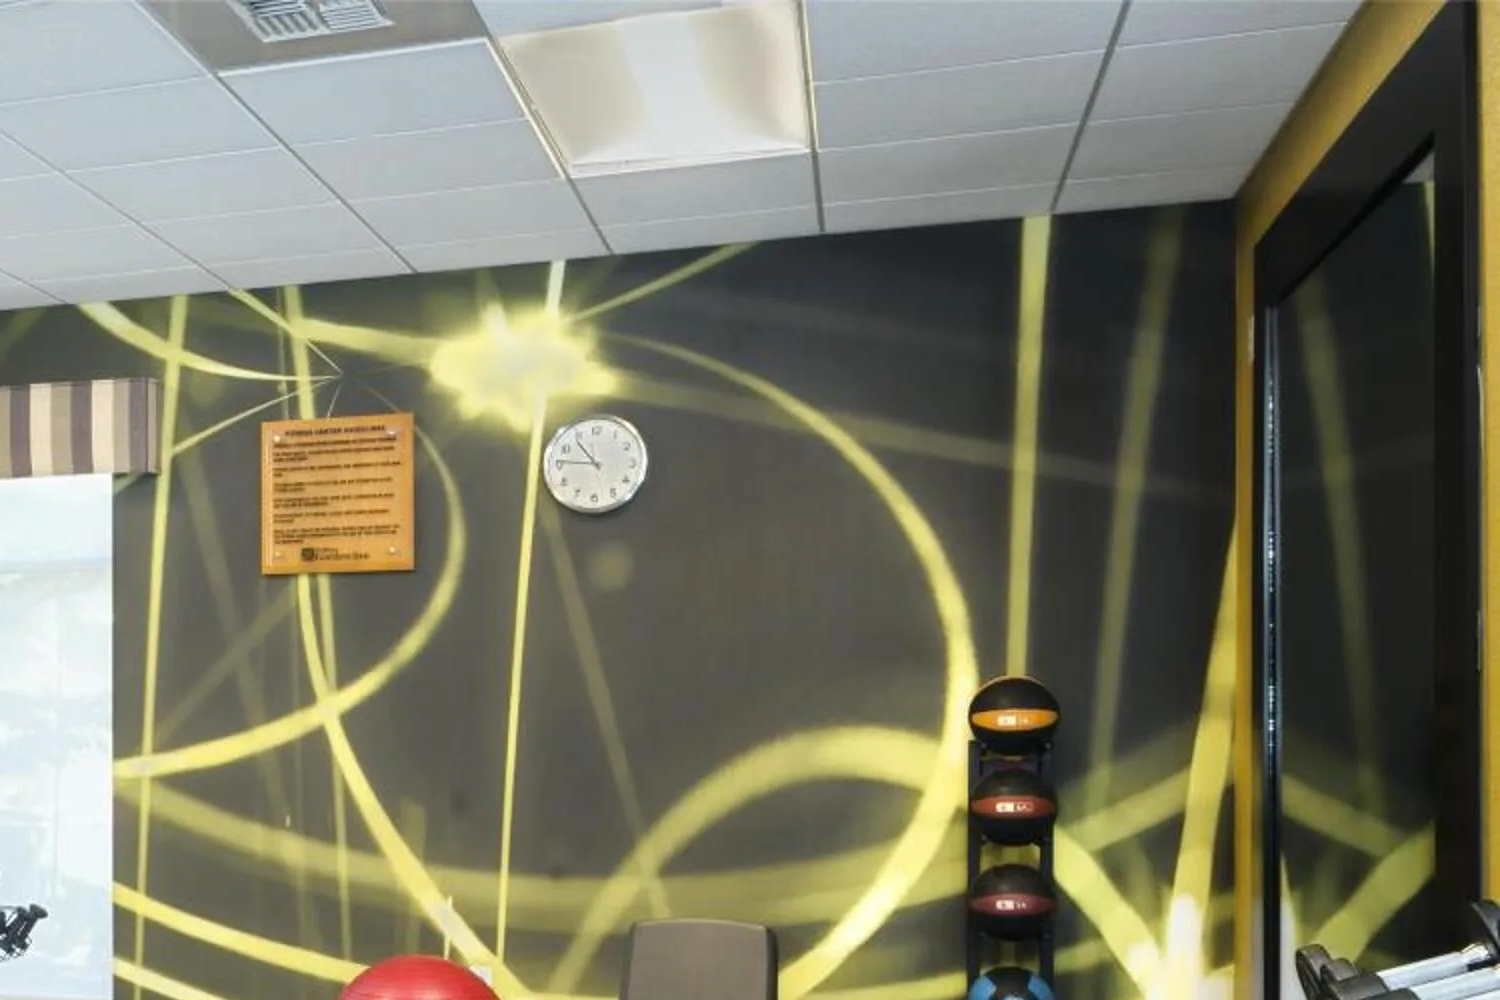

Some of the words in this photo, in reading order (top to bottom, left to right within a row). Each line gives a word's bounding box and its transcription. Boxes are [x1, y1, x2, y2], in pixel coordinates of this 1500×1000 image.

[591, 426, 603, 436] 12
[561, 444, 571, 454] 10
[590, 493, 598, 502] 6
